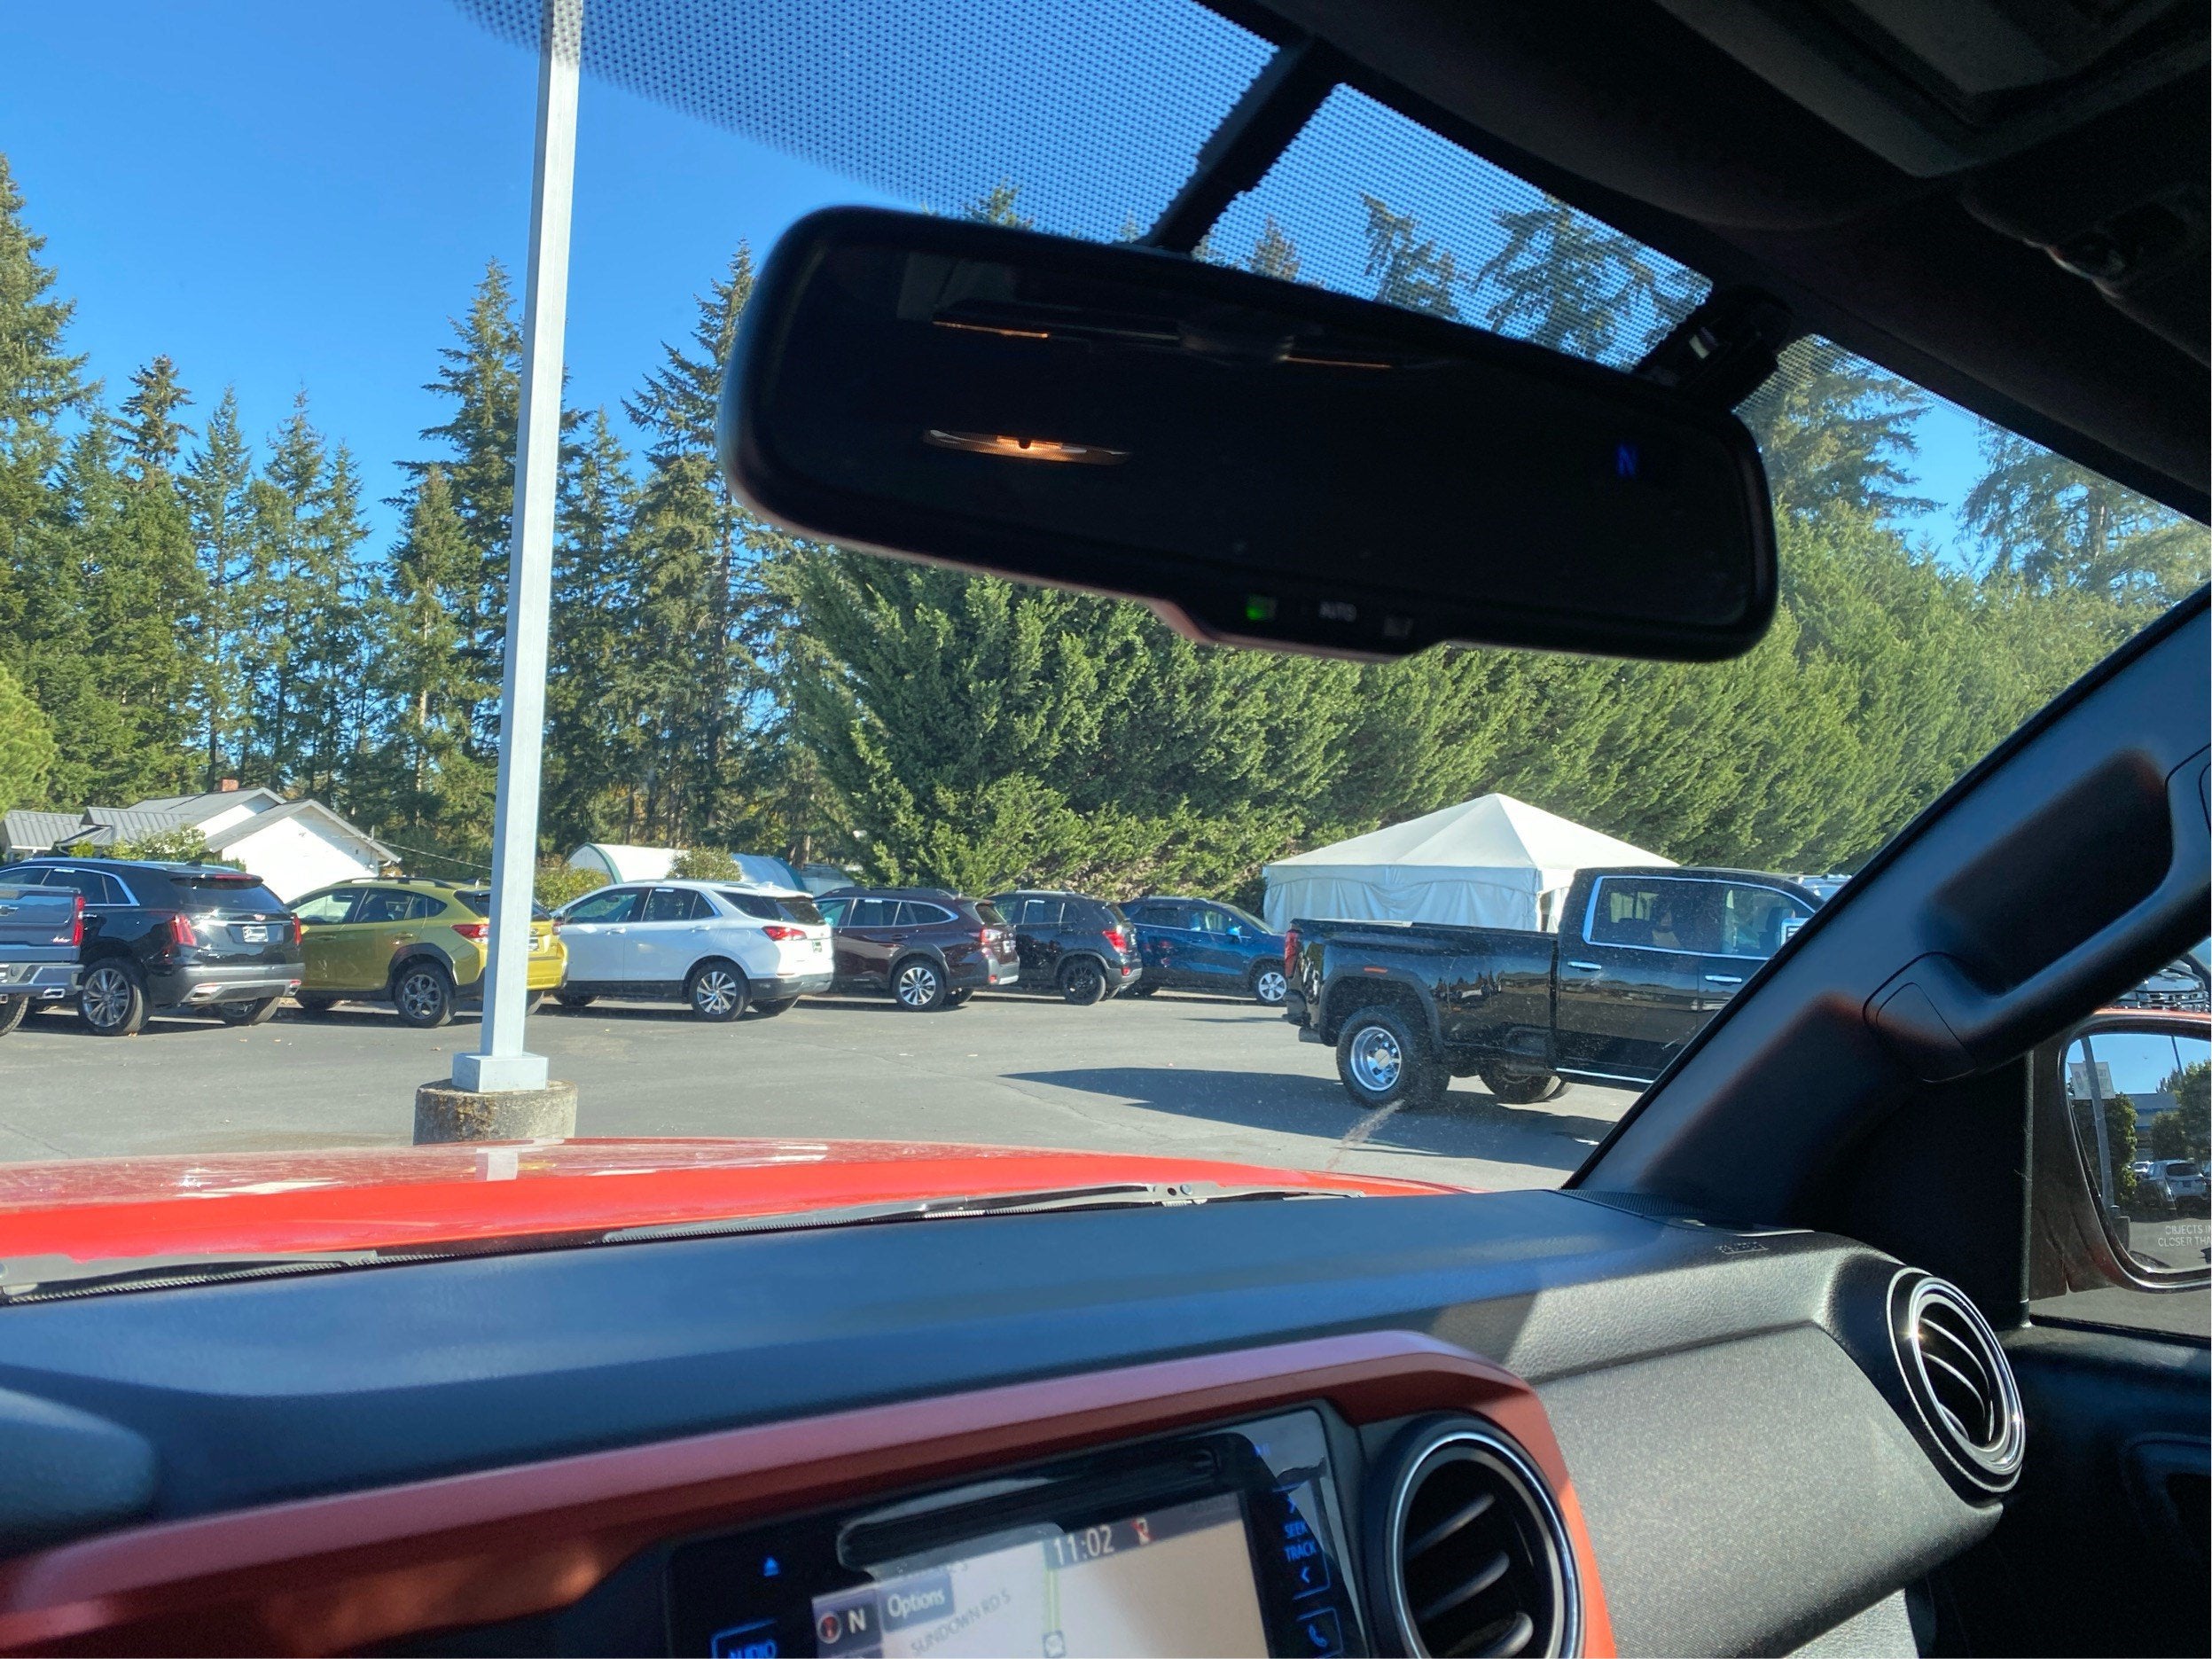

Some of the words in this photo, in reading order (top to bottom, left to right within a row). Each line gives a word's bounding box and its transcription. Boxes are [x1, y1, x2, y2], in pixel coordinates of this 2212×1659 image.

[1618, 445, 1637, 476] N
[2158, 1237, 2192, 1247] CLOSER
[2165, 1225, 2203, 1234] OBJECTS
[1285, 1521, 1308, 1539] SEEK
[1053, 1524, 1115, 1566] 11:02
[1284, 1540, 1317, 1561] TRACK
[887, 1588, 944, 1619] Options
[848, 1608, 867, 1634] N
[911, 1606, 981, 1656] SUNDOWN
[981, 1597, 1003, 1616] RD
